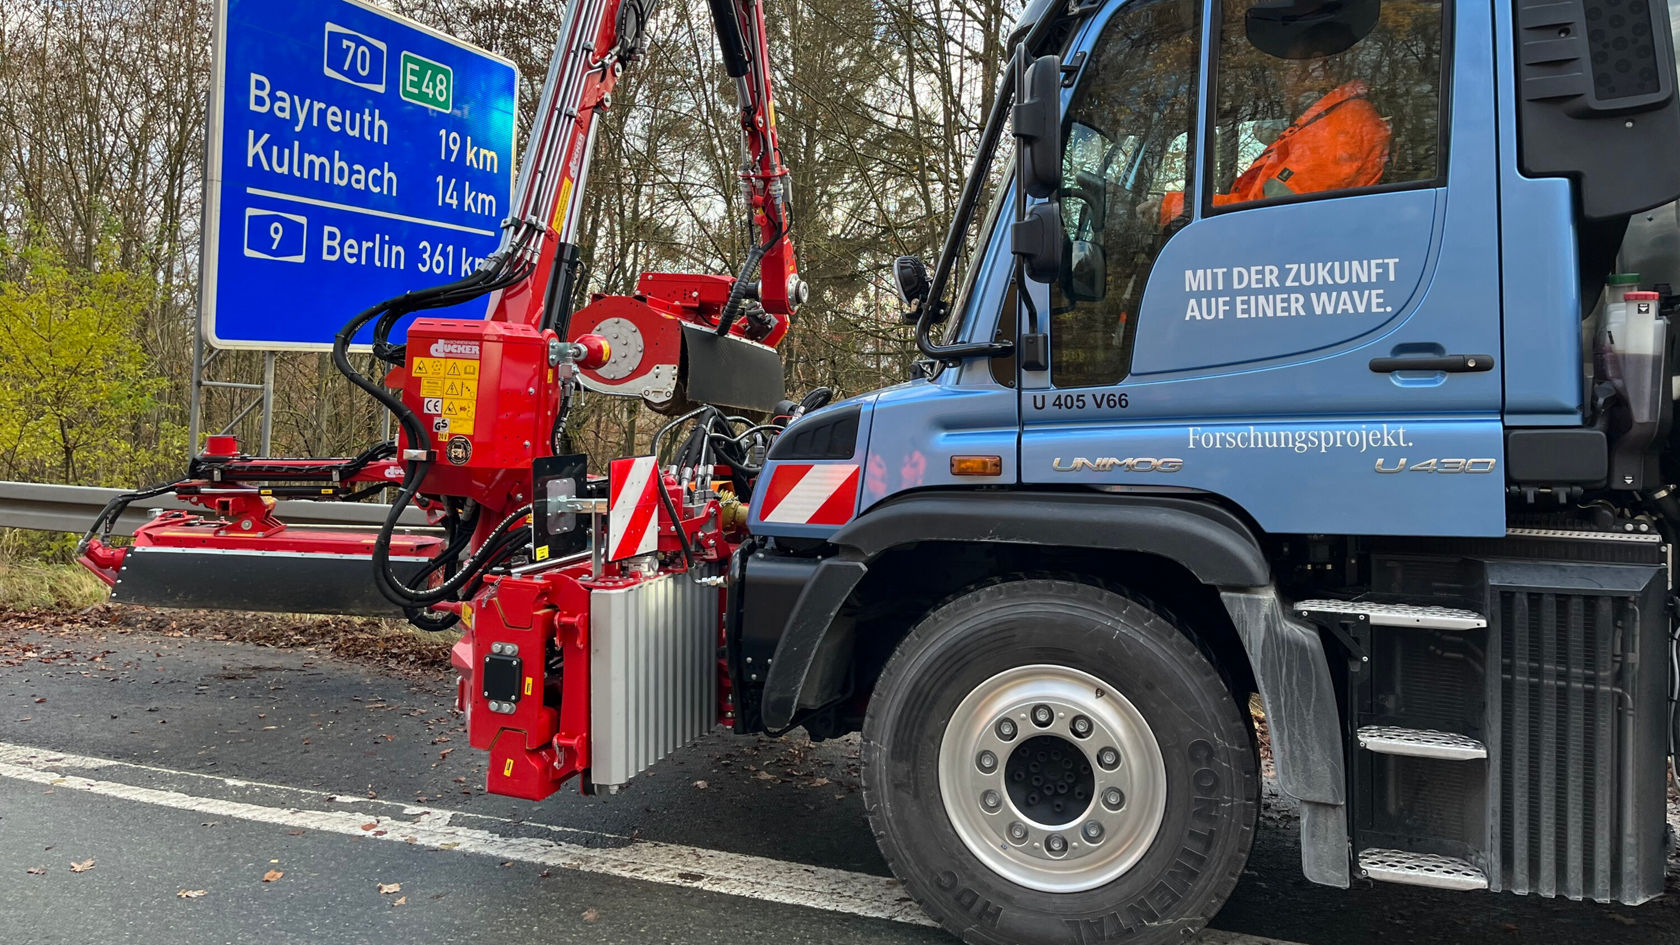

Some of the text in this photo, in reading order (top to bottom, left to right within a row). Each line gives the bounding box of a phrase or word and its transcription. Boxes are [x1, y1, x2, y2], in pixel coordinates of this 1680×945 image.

[341, 39, 371, 77] 70
[405, 63, 447, 102] E48
[249, 73, 498, 174] Bayreuth 19 km
[247, 129, 496, 217] Kulmbach 14 km
[270, 222, 283, 250] 9
[322, 225, 405, 270] Berlin
[417, 240, 454, 276] 361
[1185, 258, 1400, 291] MIT DER ZUKUNFT
[1185, 289, 1393, 321] AUF EINER WAVE.
[426, 399, 440, 412] CE
[1033, 393, 1129, 411] U 405 V66
[434, 419, 448, 431] GS
[1187, 424, 1414, 454] Forschungsprojekt.
[1052, 457, 1184, 473] UNIMOG
[1375, 457, 1497, 473] U 430
[1061, 738, 1221, 945] CONTINENTAL
[933, 869, 1004, 929] HDC
